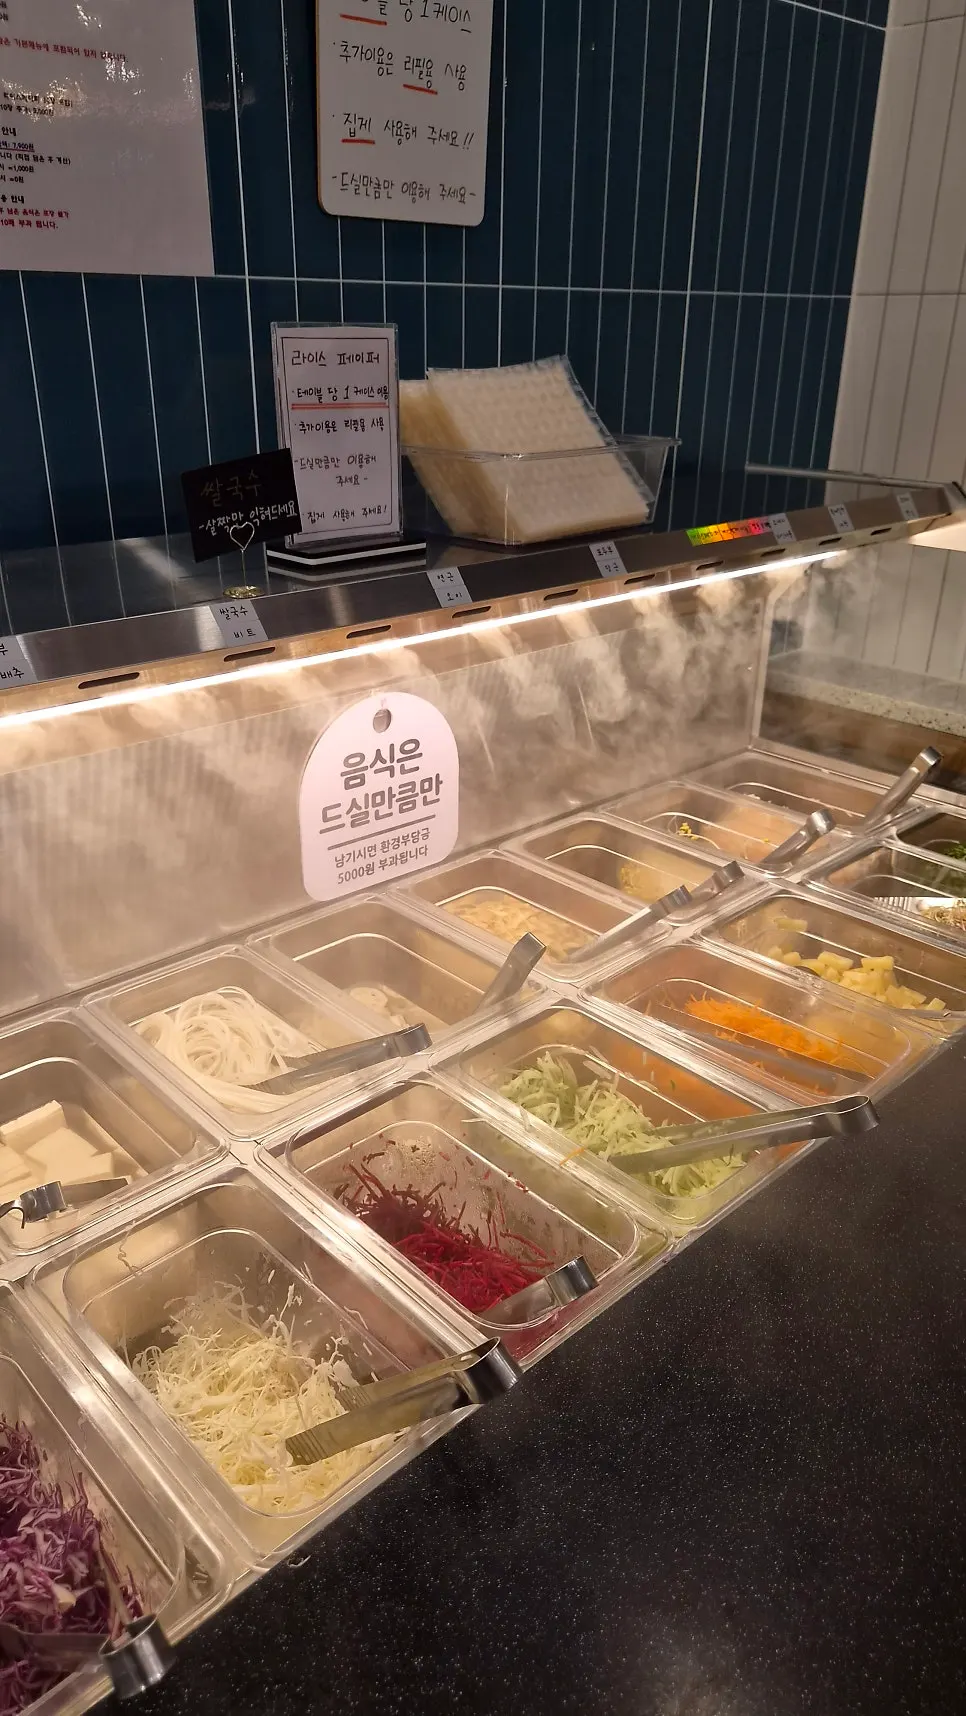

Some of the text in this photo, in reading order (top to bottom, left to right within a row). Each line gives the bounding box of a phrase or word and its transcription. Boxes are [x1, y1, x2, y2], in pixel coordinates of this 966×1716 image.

[340, 41, 467, 91] 추가이용은 리필용 사용
[1, 126, 17, 137] 안내
[343, 113, 474, 150] 집게 사용해 주세요!!
[11, 195, 25, 204] 안내
[401, 181, 430, 203] 이용해
[292, 350, 380, 366] 라이스 페이퍼
[297, 387, 323, 404] 테이블
[328, 387, 338, 401] 당
[354, 386, 375, 398] 케이스
[377, 385, 389, 400] 이용
[299, 416, 384, 434] 추가이용은 리필용 사용
[347, 453, 376, 469] 이용해
[200, 468, 262, 507] 쌀국수
[307, 505, 387, 524] 집게 사용해 주세요!
[219, 604, 248, 620] 쌀국수
[233, 628, 256, 639] 비트
[340, 738, 423, 791] 음식은
[319, 773, 443, 835] 드실만큼만
[334, 827, 431, 869] 남기시면 환경부담금
[337, 845, 429, 885] 5000원 부과됩니다
